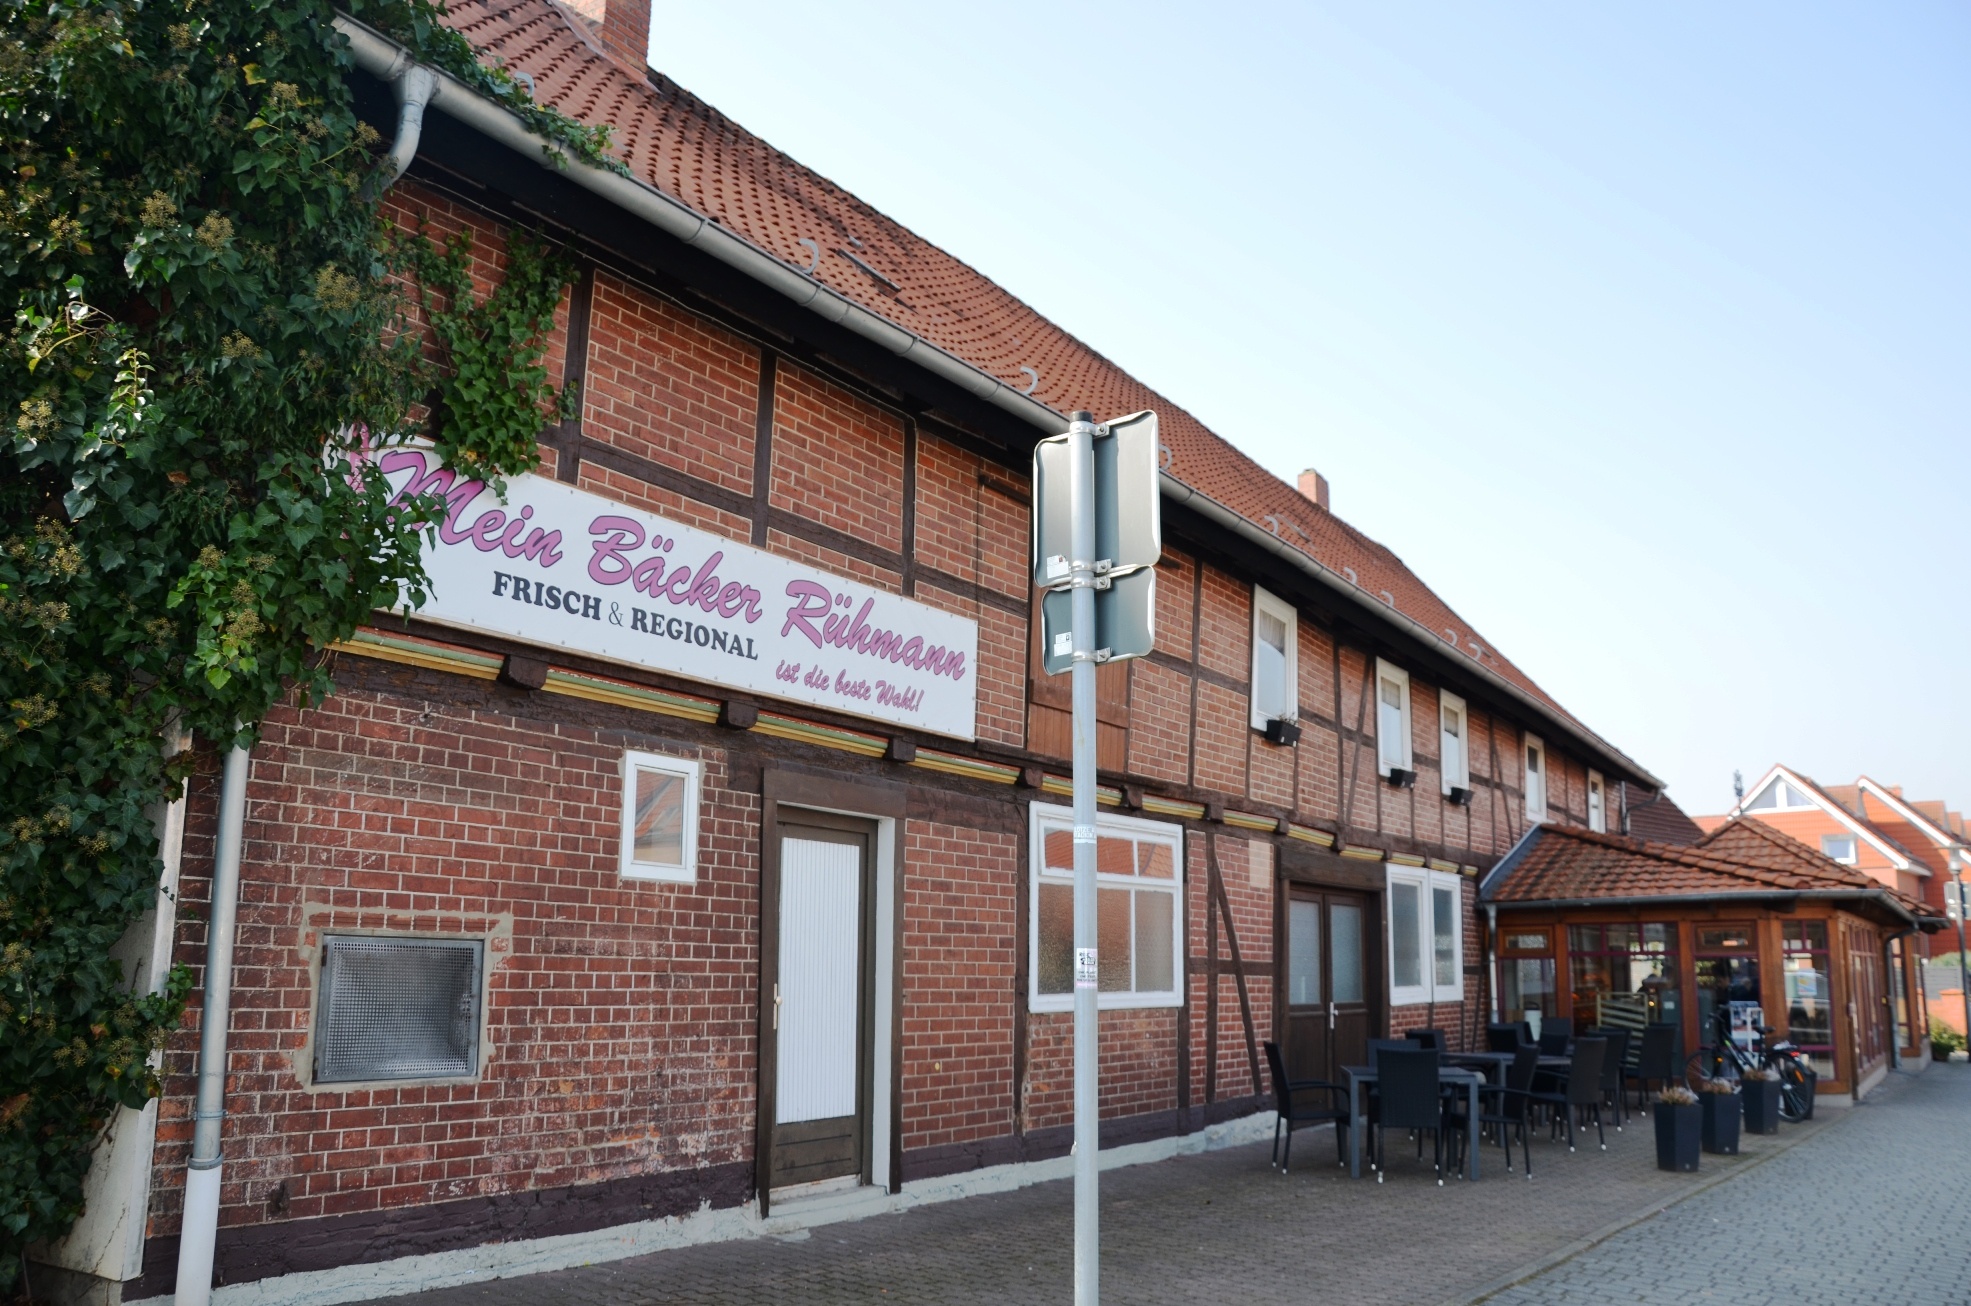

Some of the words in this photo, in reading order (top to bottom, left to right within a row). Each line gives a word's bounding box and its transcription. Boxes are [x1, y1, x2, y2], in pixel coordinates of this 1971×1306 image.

[379, 450, 563, 568] Mein
[587, 515, 762, 623] Bäcker
[780, 579, 966, 681] Rühmann
[492, 570, 602, 621] FRISCH
[608, 601, 624, 628] &
[631, 607, 759, 661] REGIONAL
[776, 659, 801, 684] ist
[804, 665, 830, 691] die
[834, 669, 872, 701] beste
[875, 680, 925, 712] Wahl!
